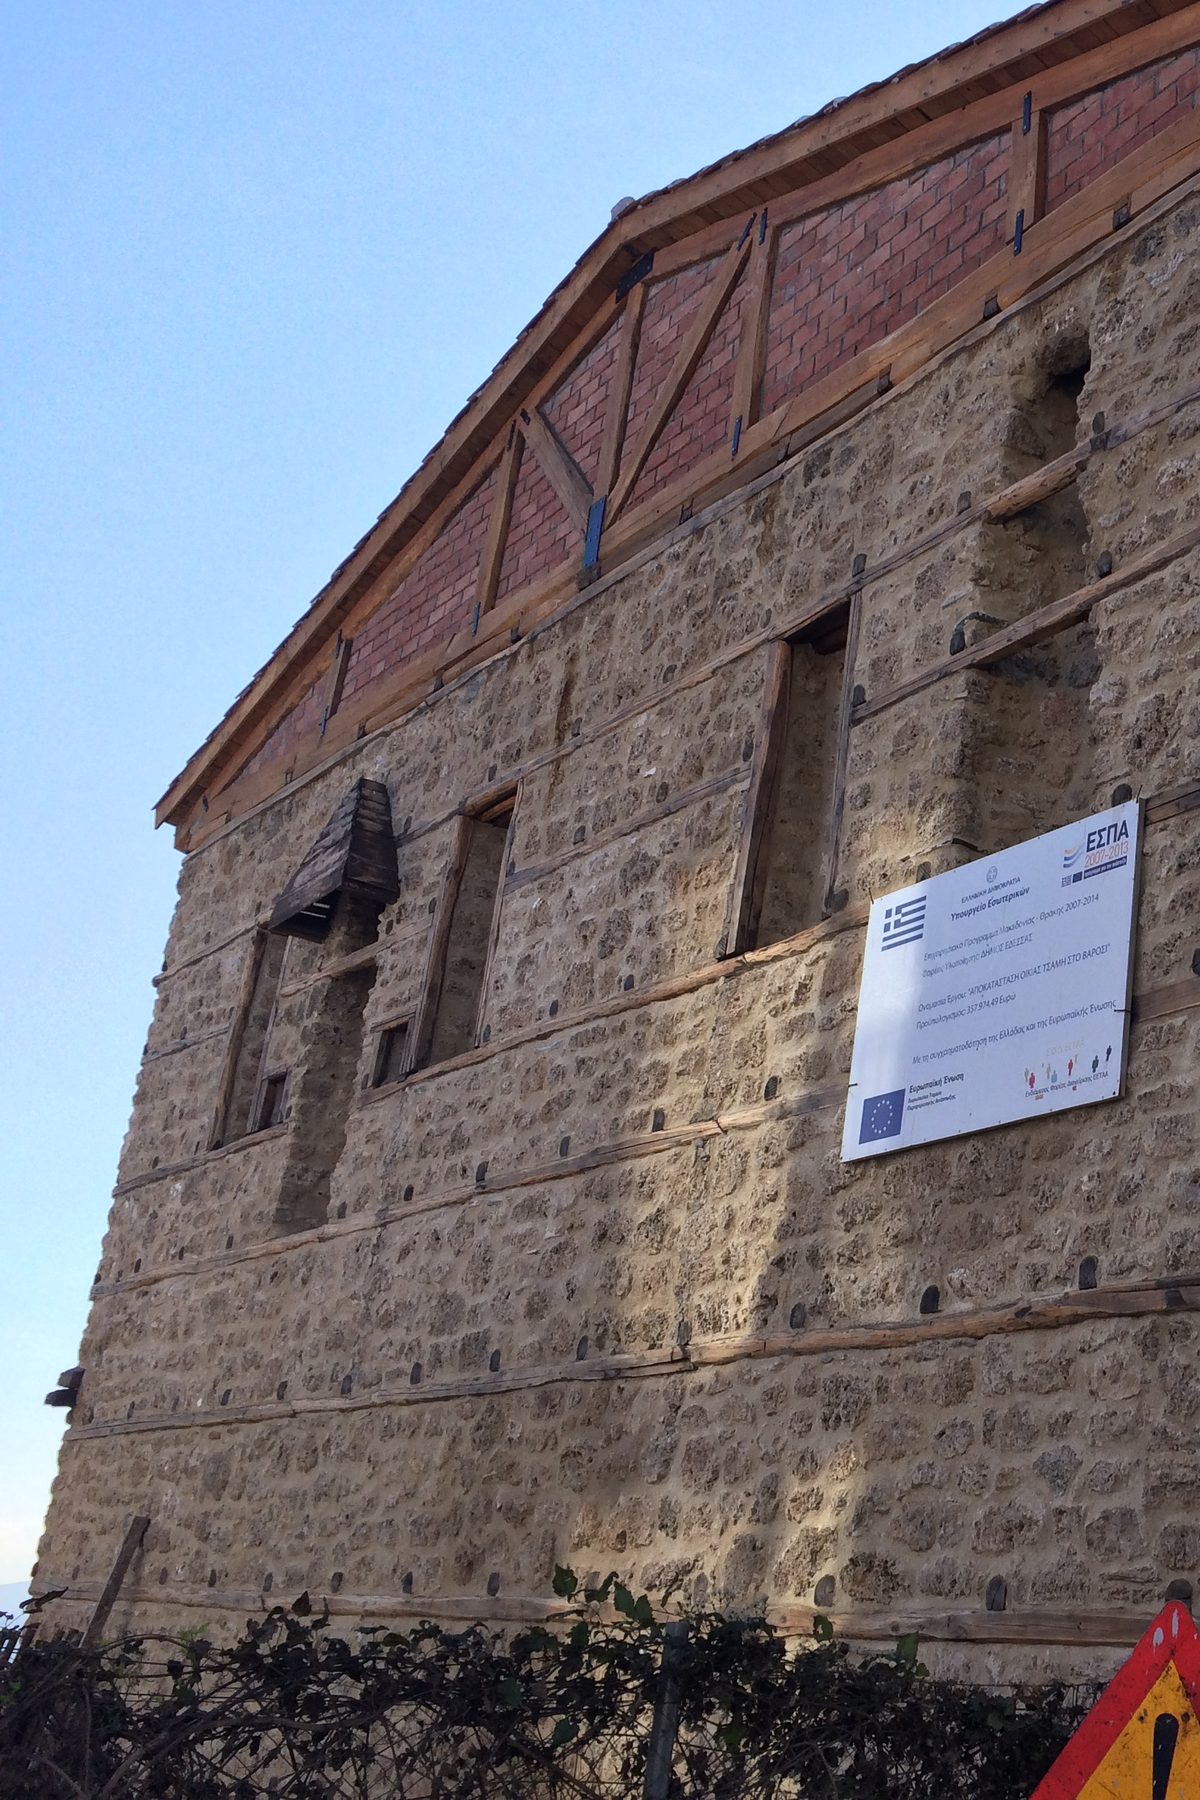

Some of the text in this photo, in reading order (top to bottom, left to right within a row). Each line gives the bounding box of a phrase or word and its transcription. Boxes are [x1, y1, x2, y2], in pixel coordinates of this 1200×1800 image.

[1086, 818, 1130, 853] ΕΣΠΑ
[1084, 839, 1129, 869] 2007-2013
[987, 875, 1021, 895] ΔΗΜΟΚΡΑΤΙΑ
[950, 900, 987, 924] Υπουργείο
[1065, 892, 1099, 913] 2007-2014
[1067, 952, 1081, 966] ΣΤΟ
[912, 1055, 922, 1066] Με
[921, 1054, 929, 1065] τη
[987, 1033, 999, 1046] της
[999, 1024, 1025, 1041] Ελλάδας
[1026, 1022, 1036, 1033] και
[1037, 1019, 1048, 1031] της
[909, 1076, 943, 1096] Ευρωπαϊκή
